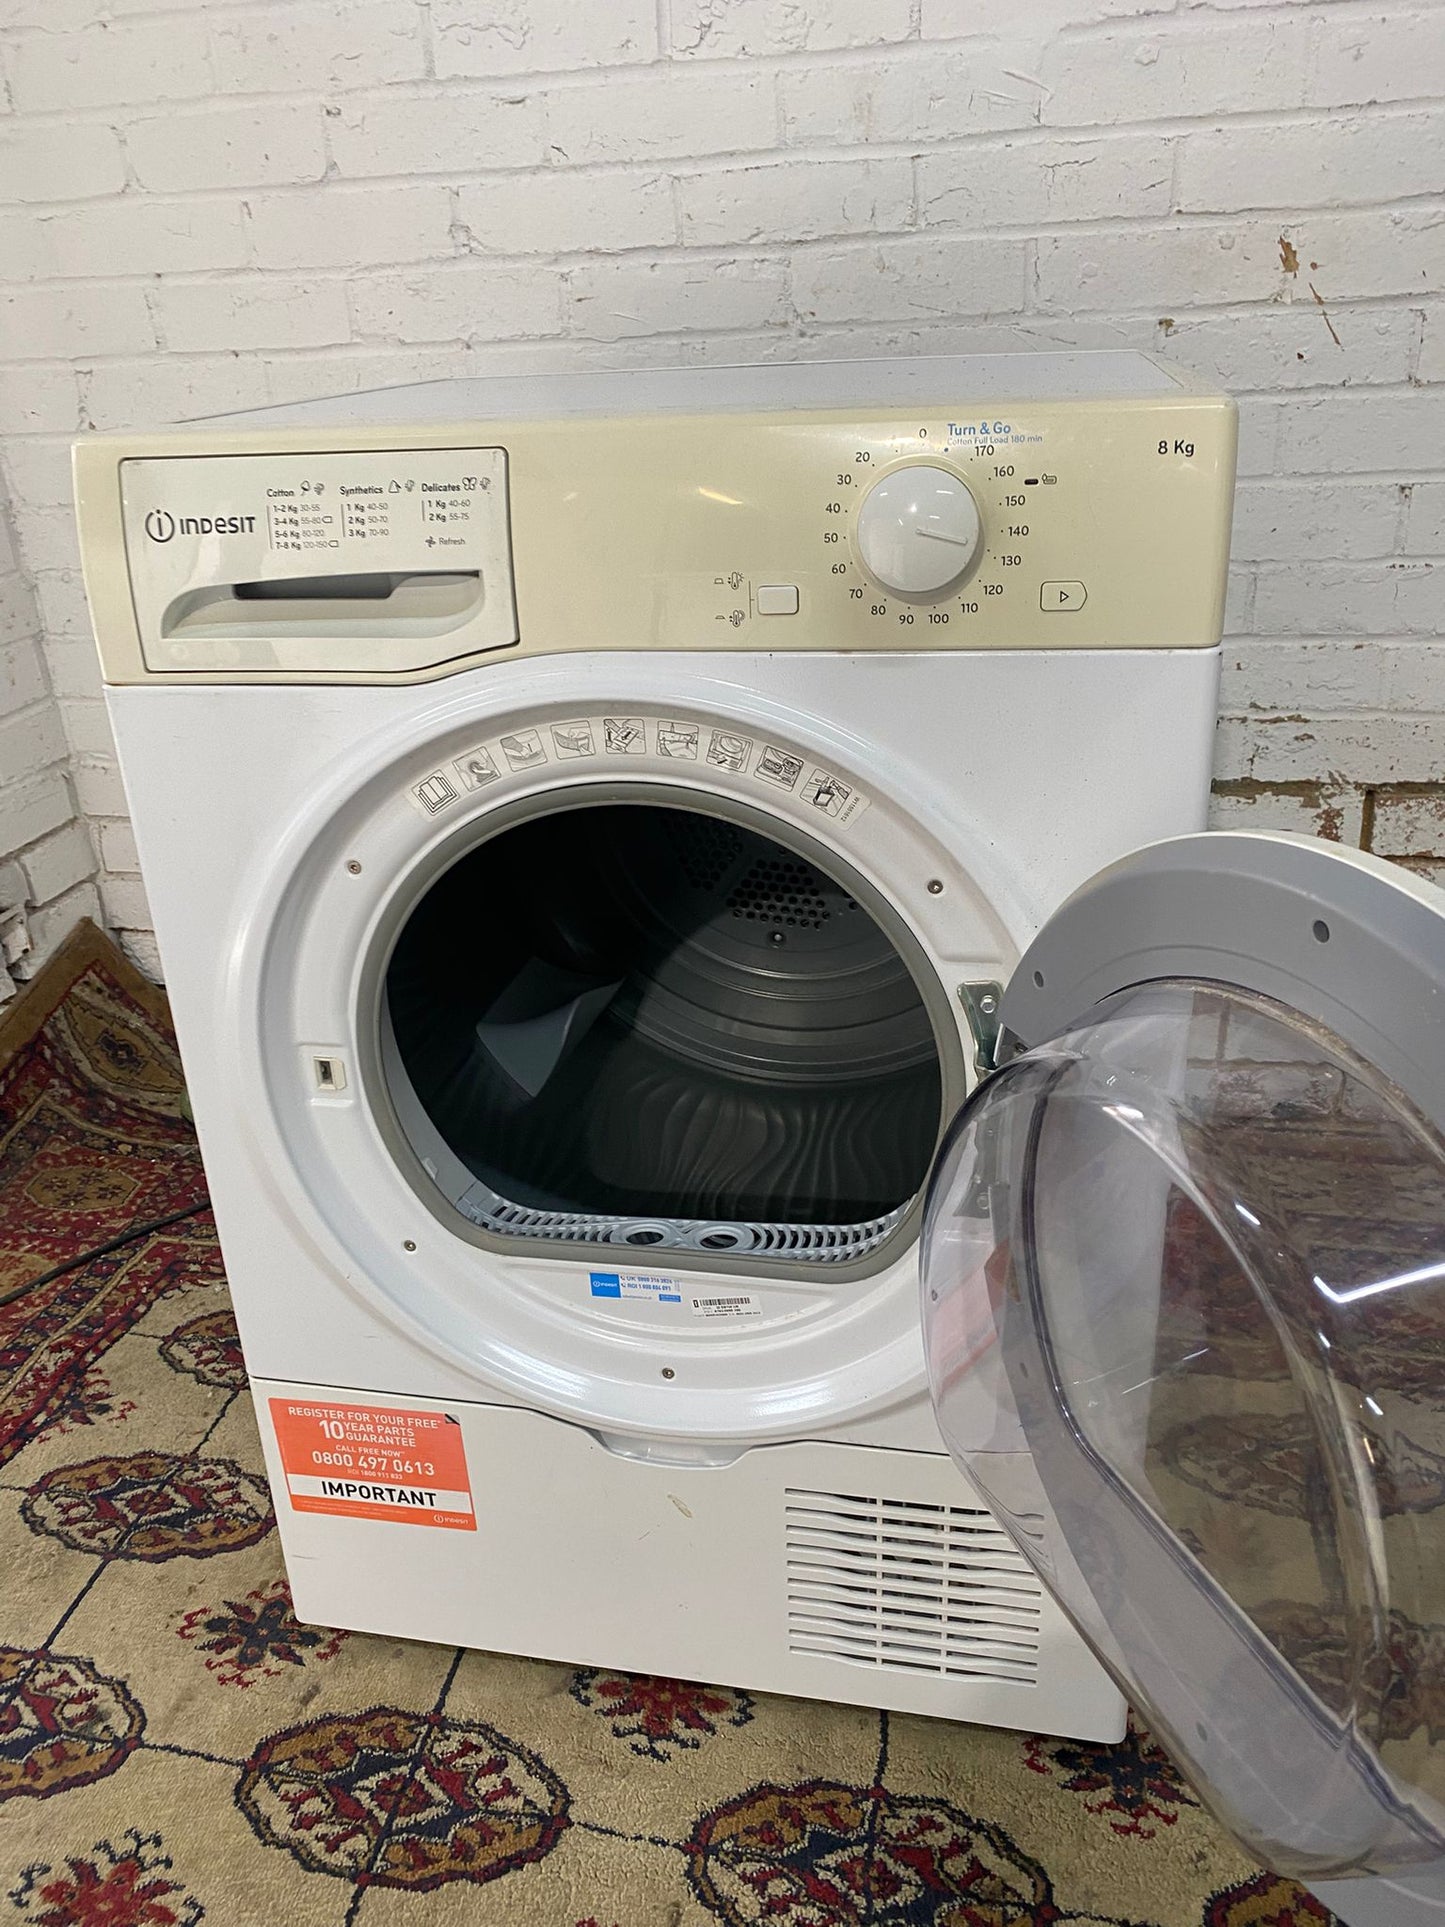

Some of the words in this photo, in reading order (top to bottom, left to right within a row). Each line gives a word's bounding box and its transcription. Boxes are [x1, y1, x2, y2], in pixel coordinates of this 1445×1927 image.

[948, 423, 976, 436] Turn
[980, 422, 990, 435] &
[993, 421, 1011, 434] Go
[919, 429, 927, 439] 0
[948, 437, 972, 446] Cotton
[974, 436, 988, 444] Full
[990, 436, 1008, 444] Load
[1011, 435, 1024, 443] 180
[975, 445, 995, 456] 170
[1157, 440, 1168, 455] 8
[1174, 439, 1195, 457] Kg
[855, 452, 870, 463] 20
[994, 466, 1015, 477] 160
[837, 474, 851, 485] 30
[339, 485, 383, 497] Synthetics
[421, 483, 460, 492] Delicates
[266, 489, 295, 497] Cotton
[436, 500, 446, 509] Kg
[448, 499, 470, 507] 40-60
[1005, 496, 1025, 506] 150
[287, 505, 298, 513] Kg
[354, 504, 365, 512] Kg
[825, 503, 840, 513] 40
[288, 518, 299, 526] Kg
[355, 517, 365, 526] Kg
[429, 513, 434, 521] 2
[436, 514, 446, 522] Kg
[274, 530, 288, 538] 5-6
[290, 531, 300, 539] Kg
[348, 529, 354, 537] 3
[356, 530, 366, 538] Kg
[1008, 526, 1029, 536] 140
[439, 537, 465, 545] Refresh
[824, 533, 838, 543] 50
[291, 542, 301, 551] Kg
[1001, 555, 1021, 566] 130
[832, 564, 846, 574] 60
[849, 588, 863, 599] 70
[983, 585, 1003, 595] 120
[871, 605, 886, 616] 80
[961, 603, 978, 613] 110
[899, 614, 914, 624] 90
[928, 614, 949, 624] 100
[288, 1406, 345, 1420] REGISTER
[348, 1412, 370, 1423] FOR
[372, 1414, 404, 1426] YOUR
[319, 1419, 345, 1440] 10
[345, 1422, 375, 1433] YEAR
[377, 1426, 414, 1437] PARTS
[345, 1431, 416, 1448] GUARANTEE
[335, 1444, 357, 1453] CALL
[358, 1446, 379, 1455] FREE
[312, 1451, 353, 1467] 0800
[358, 1455, 387, 1471] 497
[393, 1459, 435, 1476] 0613
[322, 1481, 436, 1507] IMPORTANT
